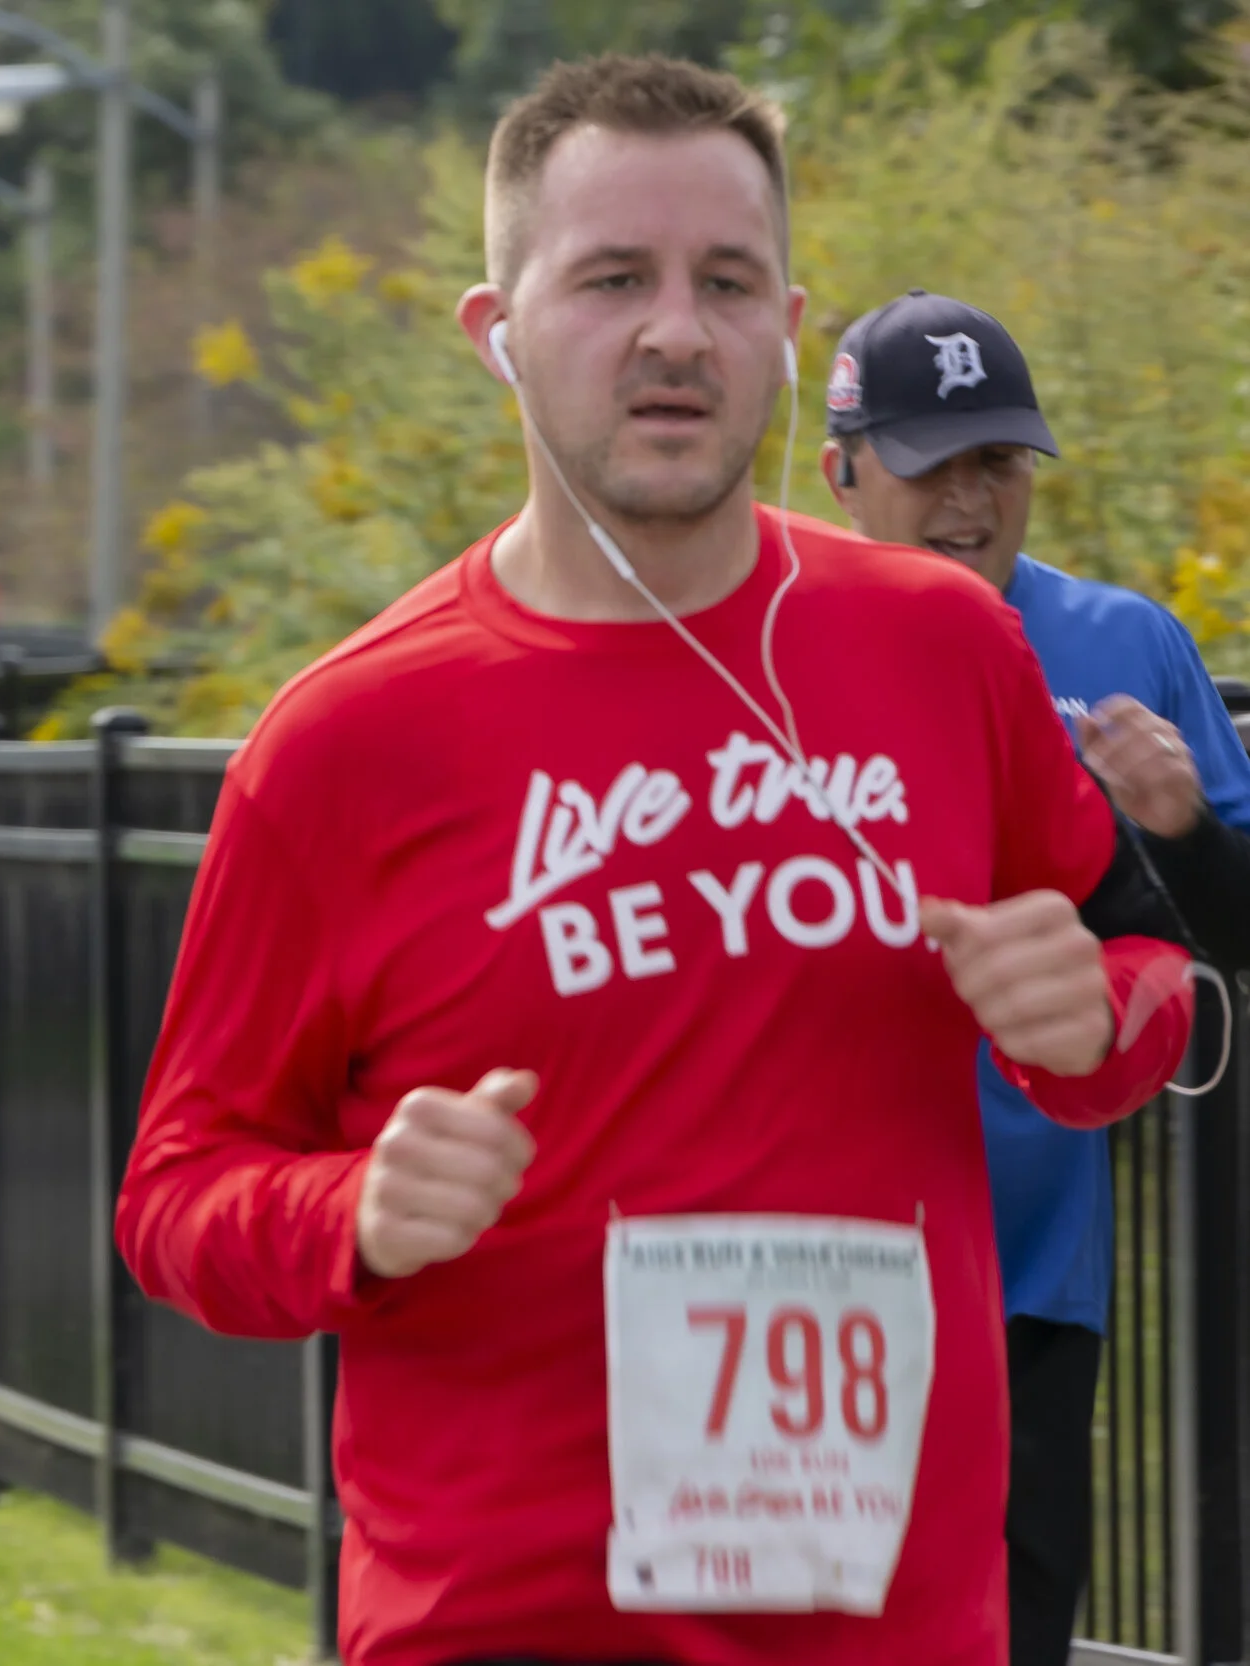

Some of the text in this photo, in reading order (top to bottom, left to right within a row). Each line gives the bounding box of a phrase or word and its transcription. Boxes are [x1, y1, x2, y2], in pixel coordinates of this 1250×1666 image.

[924, 332, 989, 400] D
[484, 762, 691, 930] Live
[539, 881, 676, 998] BE
[686, 1302, 890, 1447] 798
